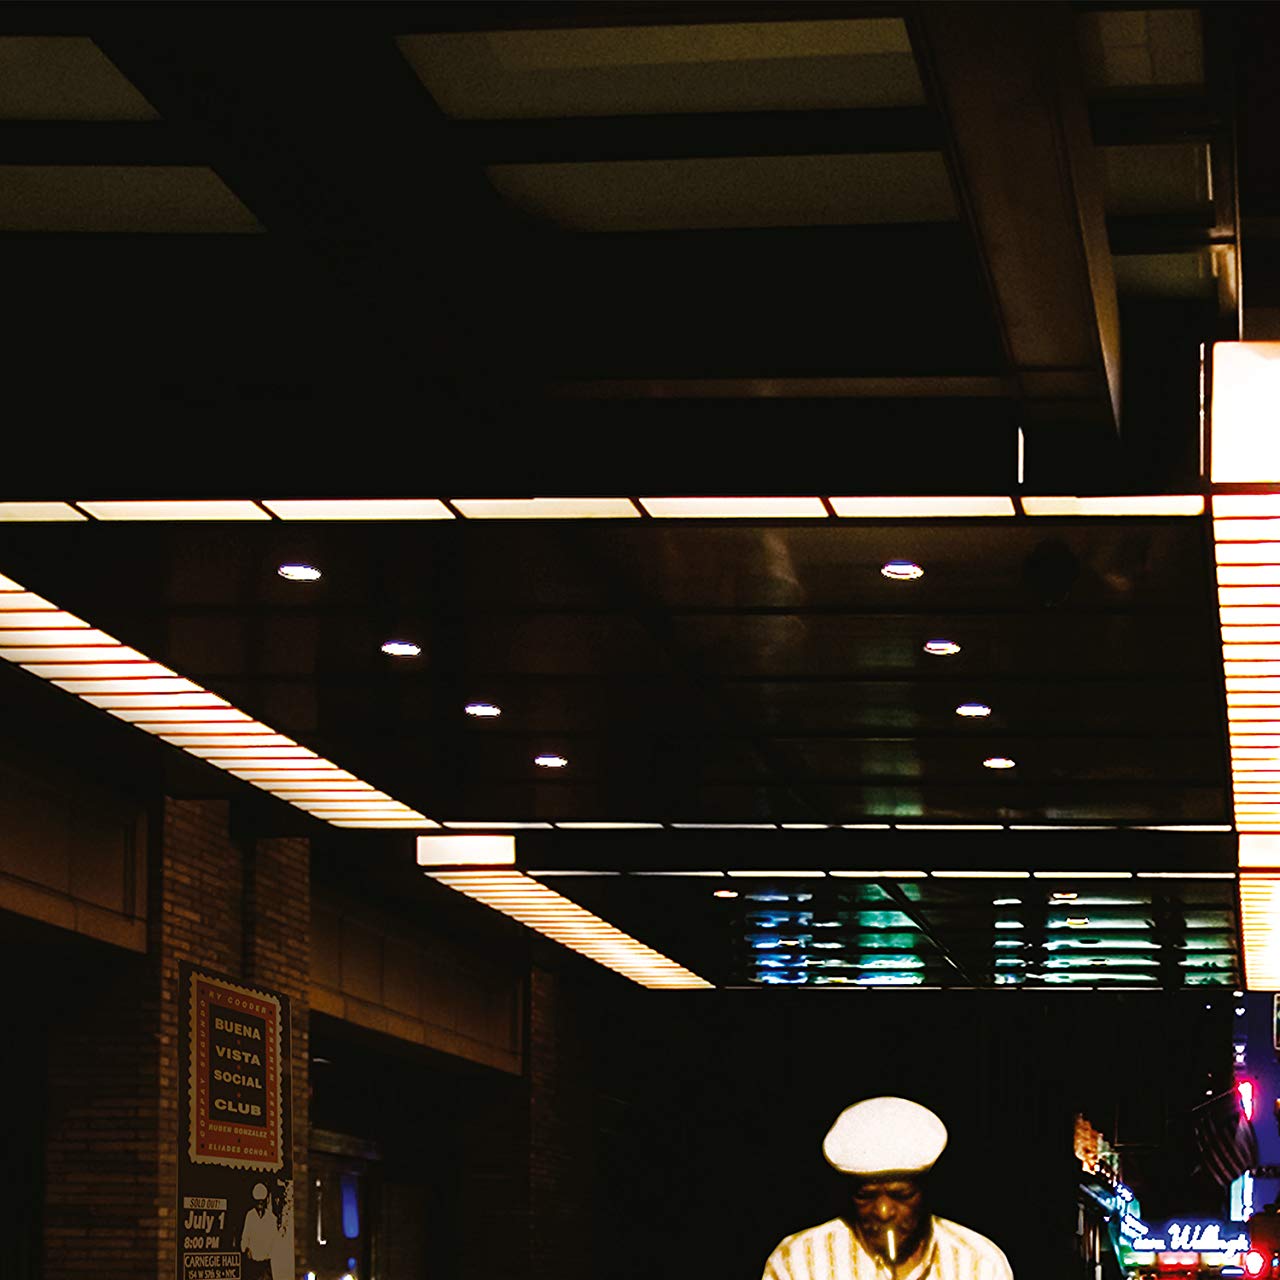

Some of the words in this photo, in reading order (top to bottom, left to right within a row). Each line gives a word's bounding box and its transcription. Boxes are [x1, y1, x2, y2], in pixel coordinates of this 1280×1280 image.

[209, 991, 223, 1001] RY
[227, 996, 267, 1014] COODER
[215, 1017, 261, 1040] BUENA
[215, 1044, 261, 1067] VISTA
[214, 1069, 262, 1089] SOCIAL
[214, 1098, 262, 1117] CLUB
[208, 1143, 242, 1154] ELIADES
[243, 1147, 268, 1157] OCHOA
[190, 1198, 206, 1209] SOLD
[184, 1210, 215, 1234] July
[218, 1211, 226, 1230] 1
[184, 1236, 204, 1249] 8:00
[205, 1236, 220, 1249] PM
[185, 1255, 221, 1268] CARNEGIE
[222, 1255, 241, 1267] HALL
